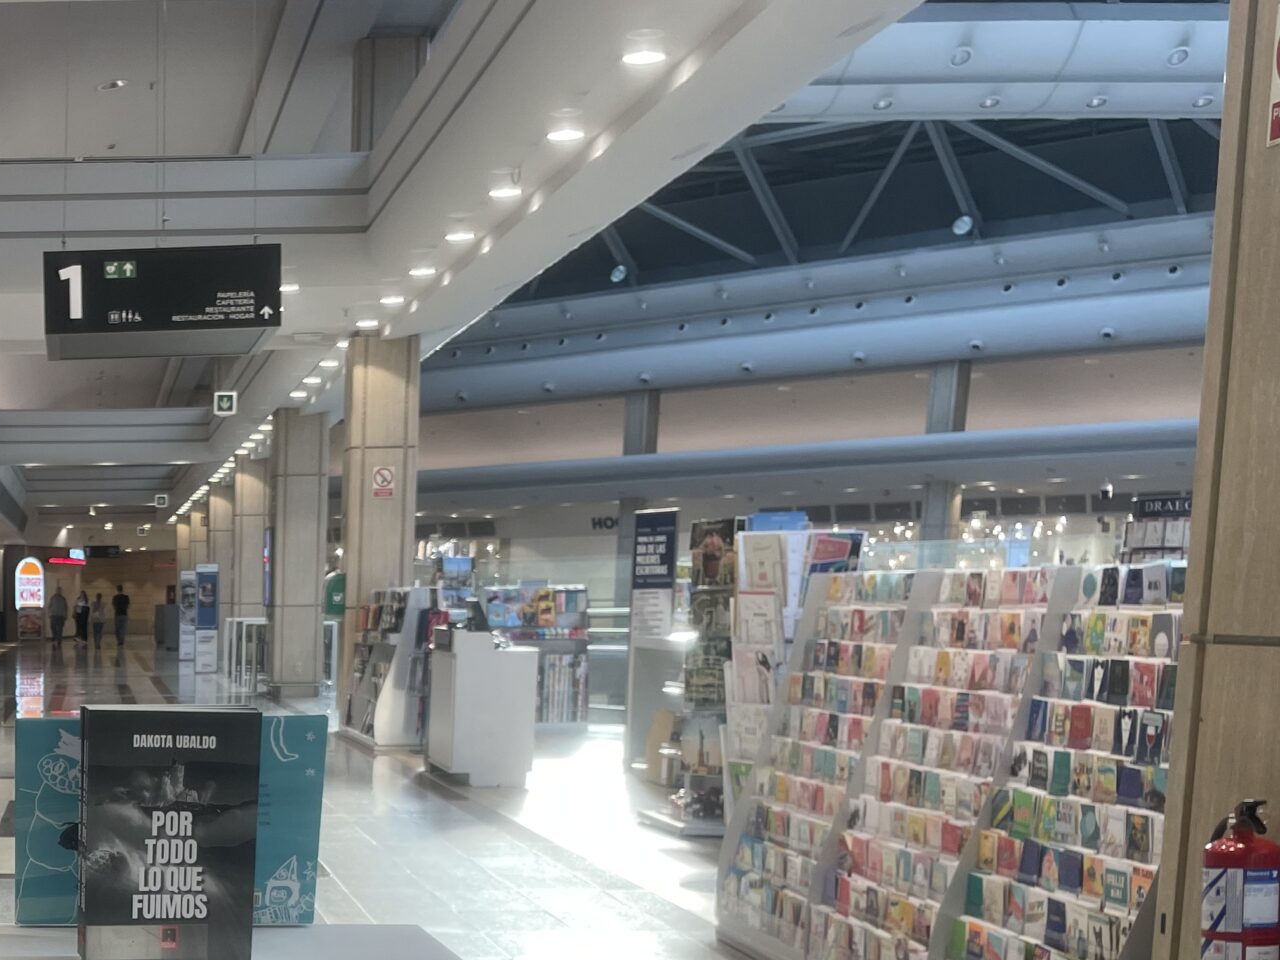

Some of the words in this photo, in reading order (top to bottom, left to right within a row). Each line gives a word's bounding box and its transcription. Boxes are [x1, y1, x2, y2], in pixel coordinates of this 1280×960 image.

[58, 264, 83, 320] 1
[591, 516, 619, 529] HO
[133, 734, 173, 748] DAKOTA
[176, 735, 216, 749] UBALDO
[151, 811, 192, 836] POR
[145, 839, 197, 864] TODO
[138, 867, 161, 891] LO
[165, 867, 202, 893] QUE
[132, 895, 207, 919] FUIMOS
